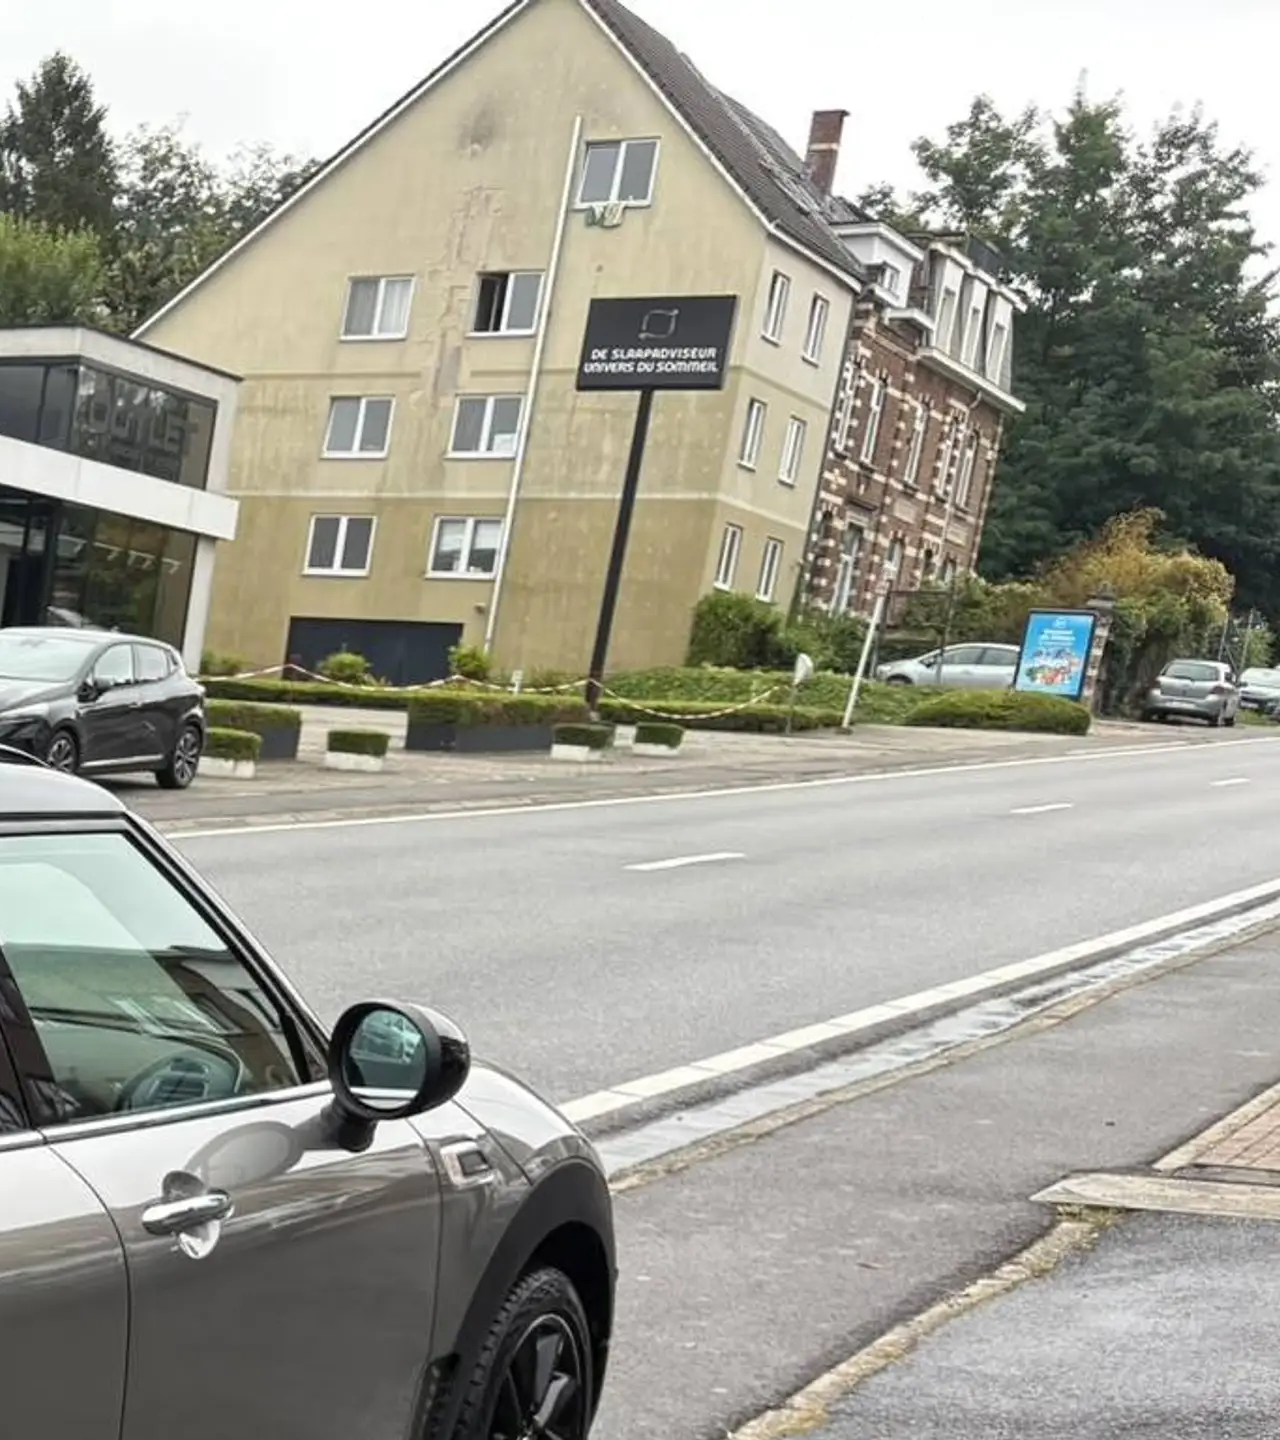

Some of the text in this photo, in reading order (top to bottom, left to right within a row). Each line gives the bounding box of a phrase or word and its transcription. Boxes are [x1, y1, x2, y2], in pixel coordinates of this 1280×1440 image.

[591, 347, 717, 360] DE SLAAPADVISEUR
[584, 361, 719, 373] UNIVERS DU SOMMEIL
